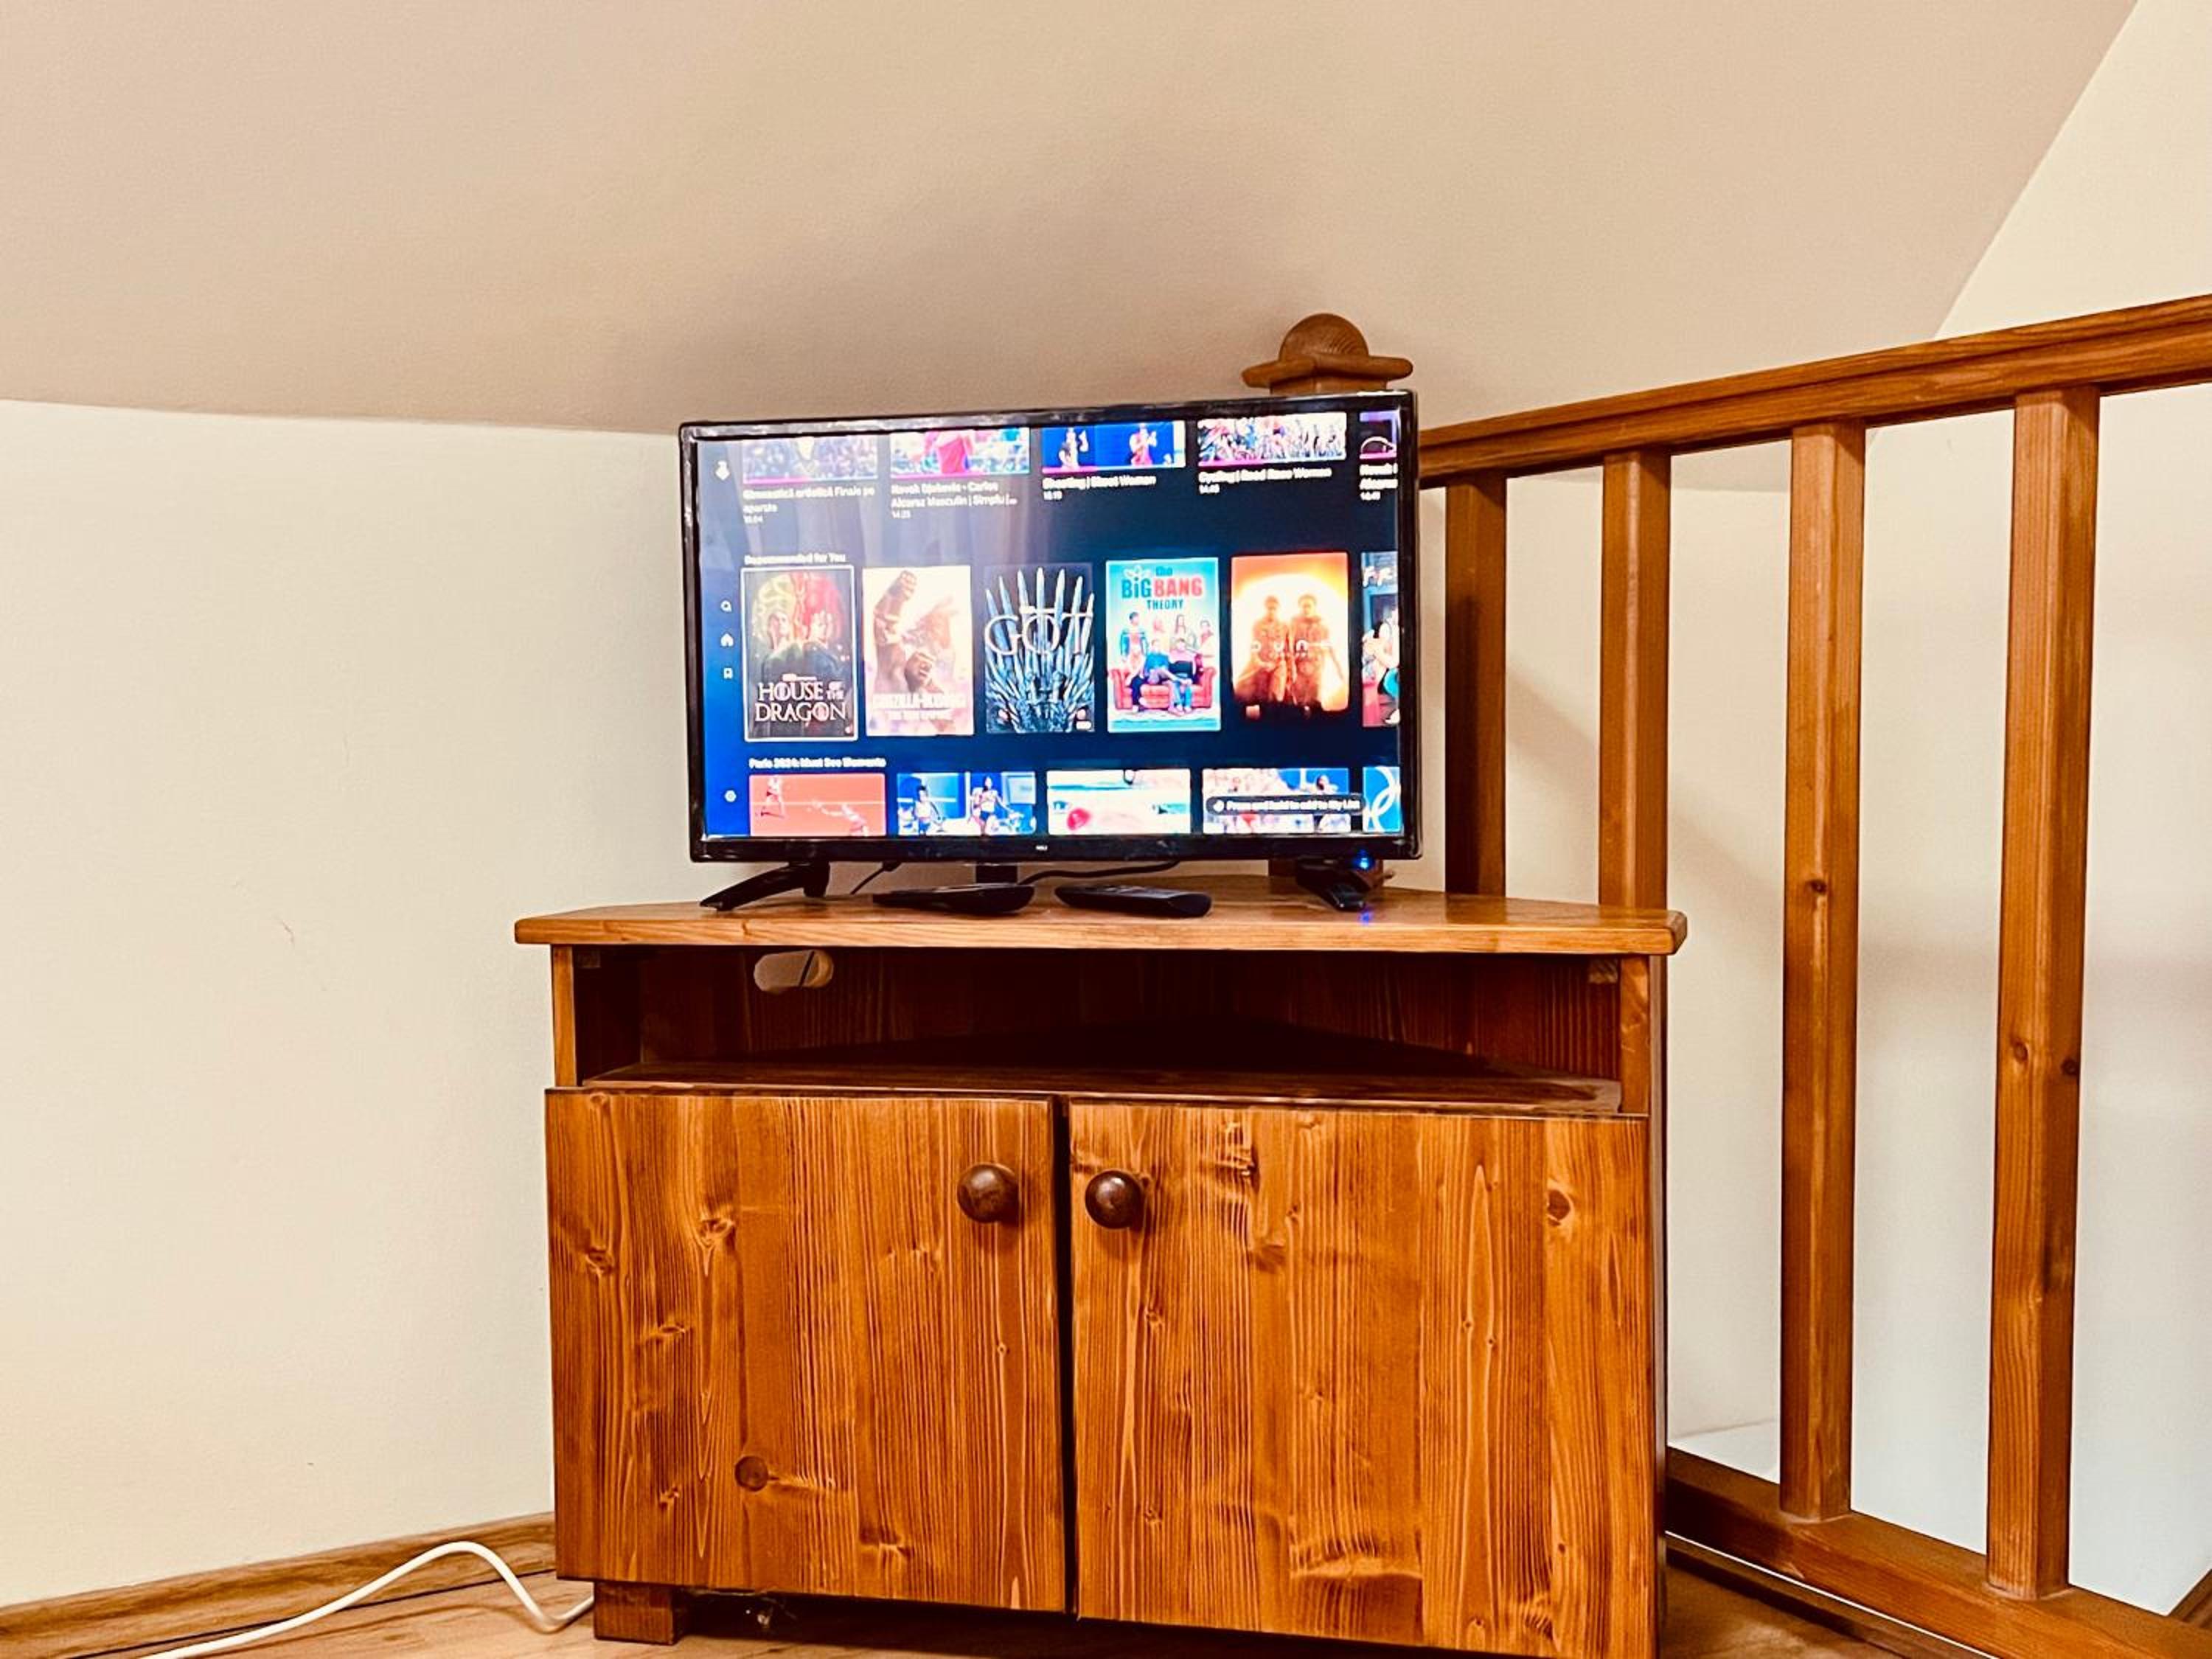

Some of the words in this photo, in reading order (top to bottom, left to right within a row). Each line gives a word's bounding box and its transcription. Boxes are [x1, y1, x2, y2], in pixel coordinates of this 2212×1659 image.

[835, 486, 862, 497] Finale
[1152, 575, 1203, 598] BANG
[1146, 599, 1184, 611] THEORY
[758, 682, 824, 701] HOUSE
[754, 701, 846, 723] DRAGON
